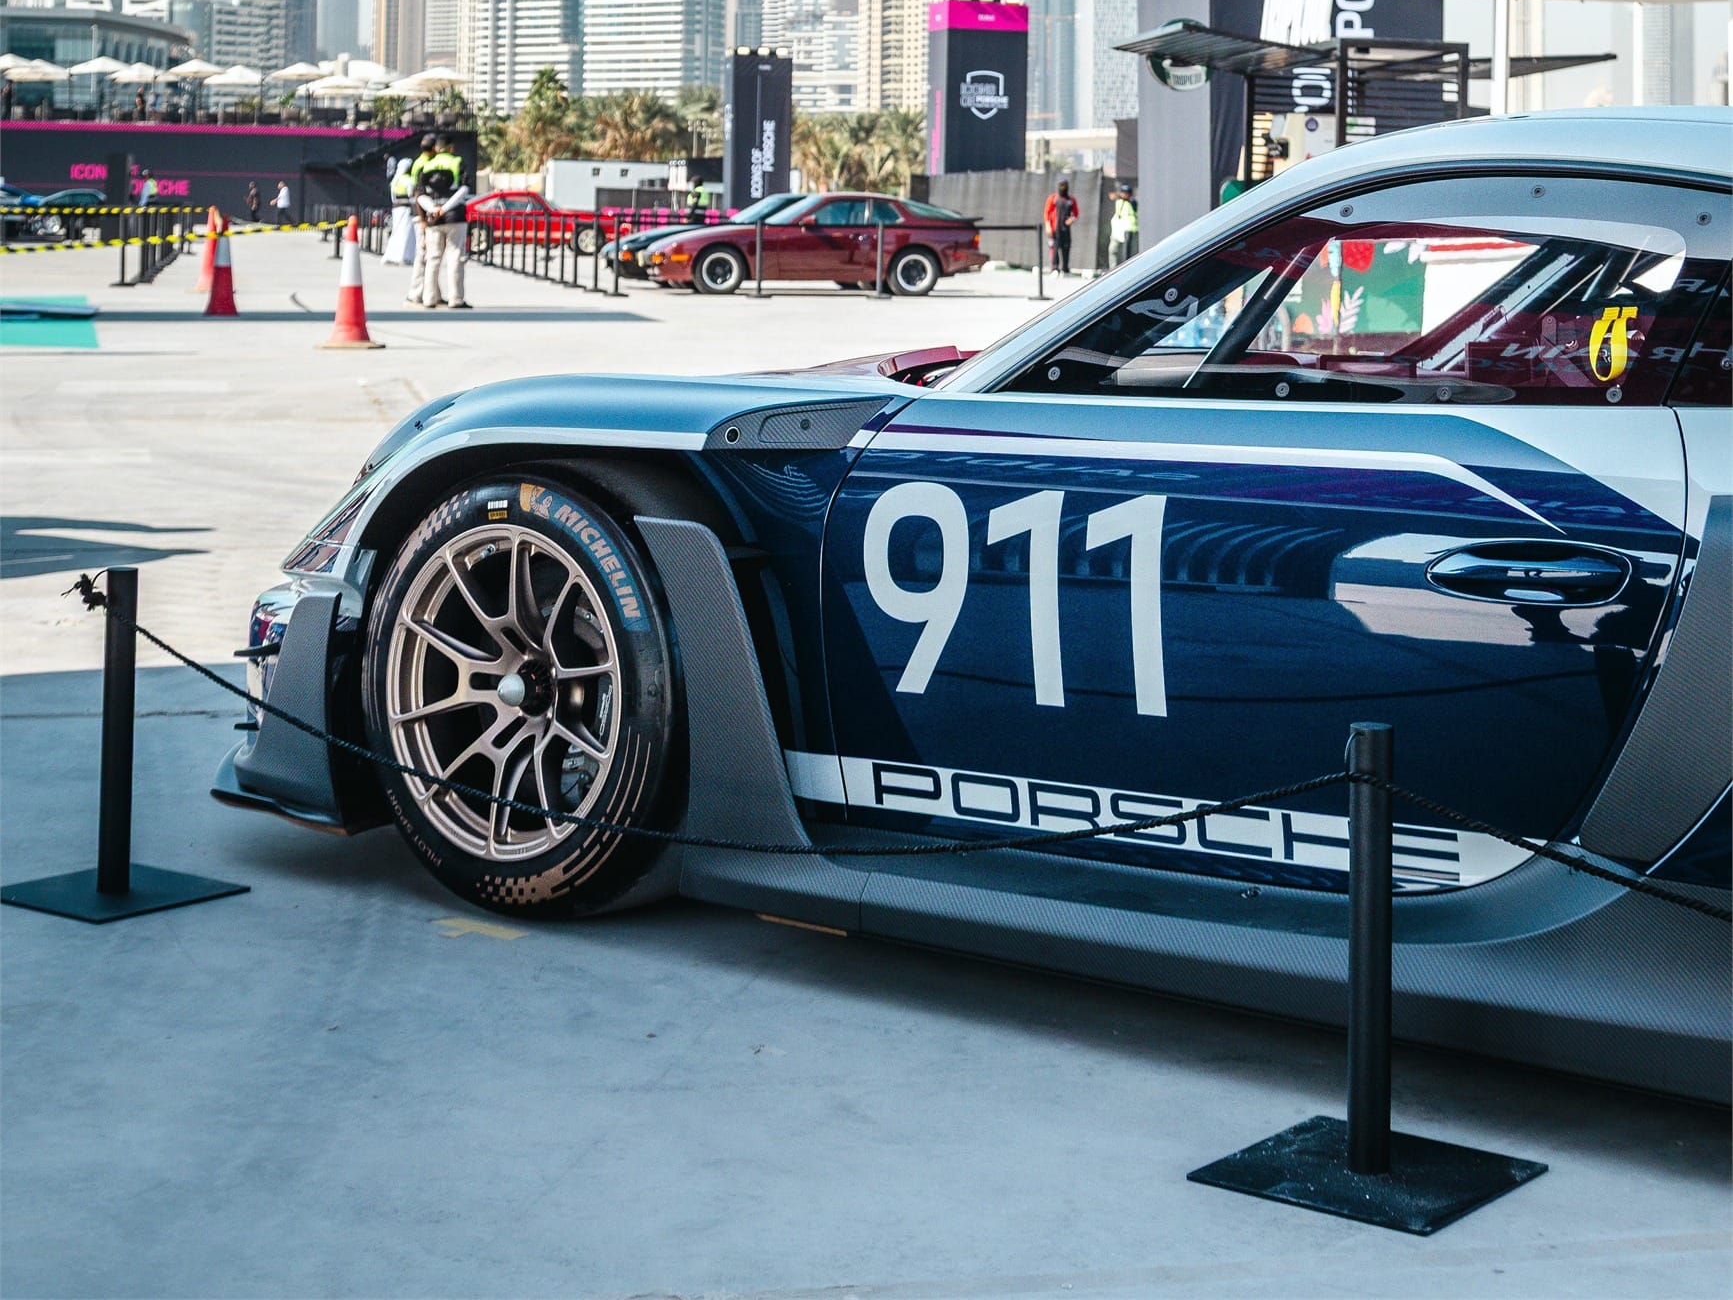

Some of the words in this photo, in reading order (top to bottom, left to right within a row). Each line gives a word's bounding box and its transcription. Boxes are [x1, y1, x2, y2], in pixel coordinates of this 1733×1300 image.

[751, 147, 763, 164] OF
[762, 119, 776, 172] PORSCHE
[751, 165, 763, 199] ICONS
[554, 504, 642, 620] MICHELIN
[863, 480, 1169, 718] 911
[386, 789, 414, 834] SPORT
[872, 762, 1462, 883] PORSCHE
[413, 835, 443, 868] PILOT
